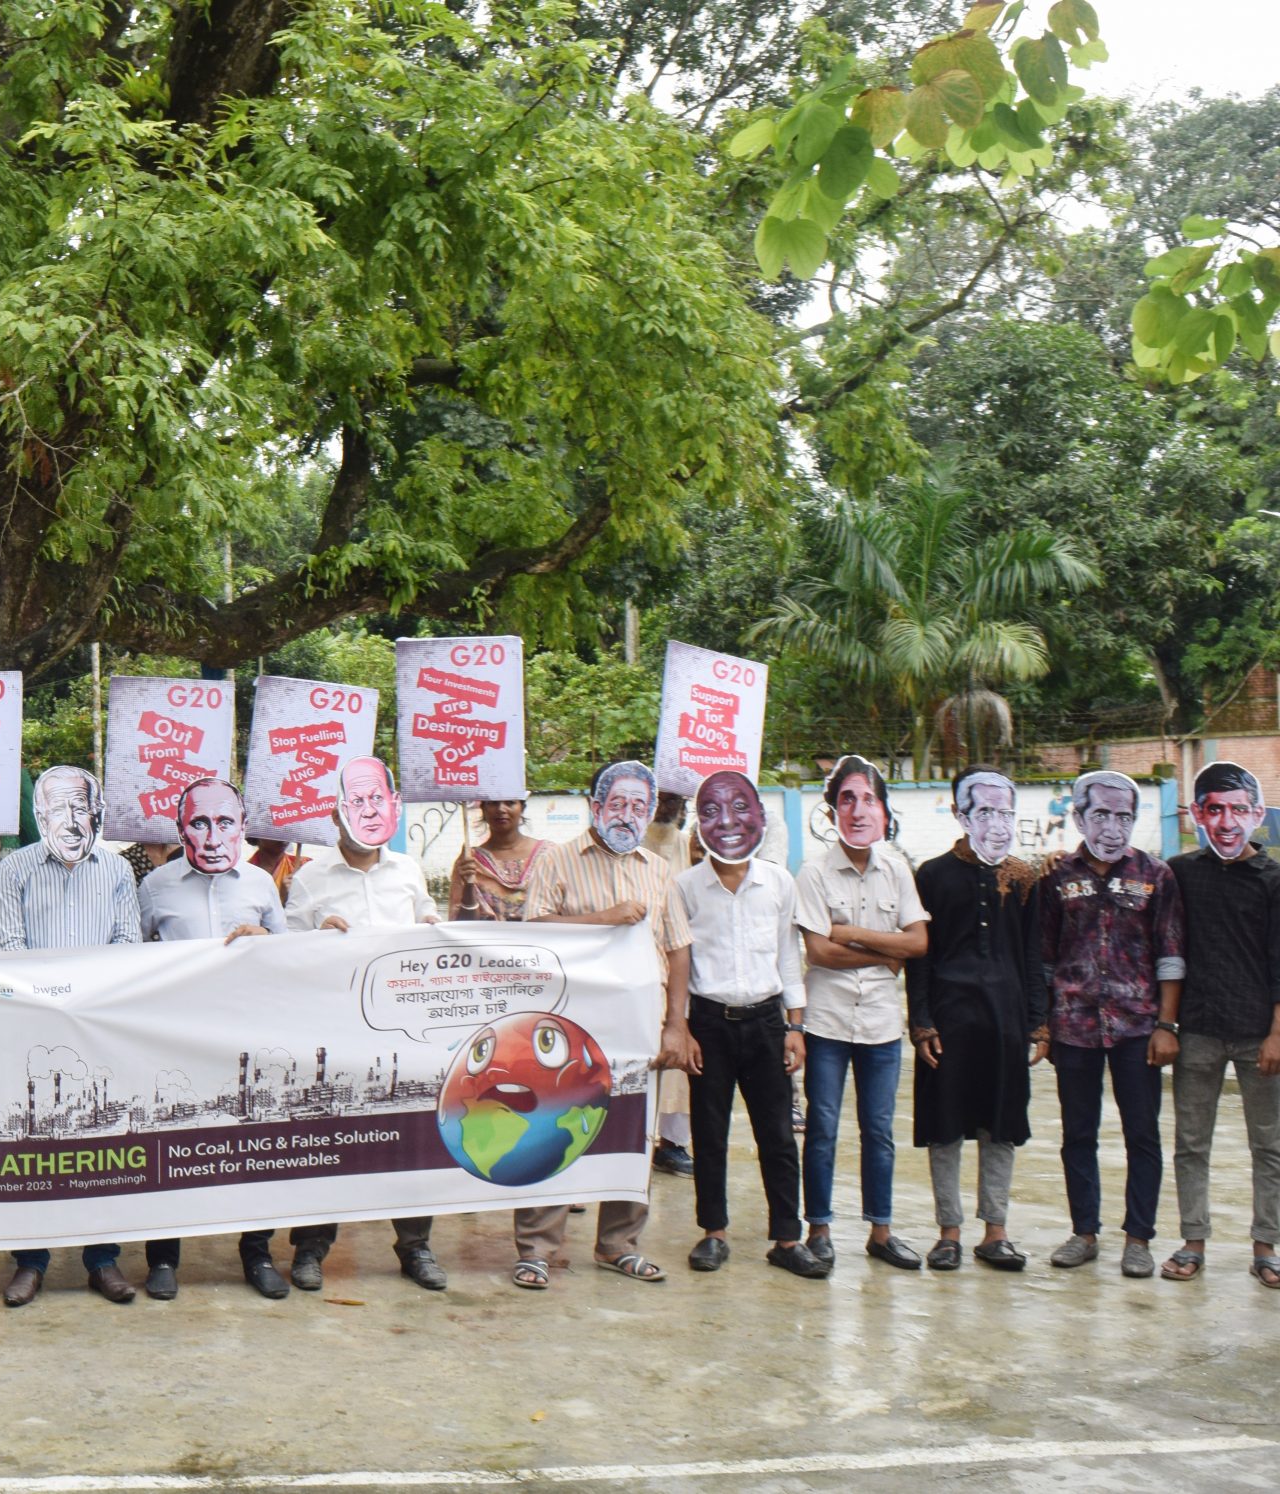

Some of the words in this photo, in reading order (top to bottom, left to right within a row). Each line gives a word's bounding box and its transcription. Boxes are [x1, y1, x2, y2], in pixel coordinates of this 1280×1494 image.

[450, 644, 505, 667] G20
[712, 660, 756, 687] G20
[423, 673, 443, 685] Your
[444, 678, 496, 698] Investments
[167, 685, 223, 709] G20
[309, 687, 363, 714] G20
[691, 687, 734, 707] Support
[442, 700, 468, 714] are
[705, 711, 725, 723] for
[154, 719, 193, 745] Out
[417, 717, 499, 741] Destroying
[688, 720, 729, 750] 100%
[272, 736, 297, 748] Stop
[299, 731, 345, 744] Fuelling
[143, 746, 179, 760] from
[301, 751, 325, 766] Coal
[443, 740, 475, 762] Our
[682, 751, 746, 767] Renewabls
[292, 767, 316, 782] LNG
[438, 768, 477, 782] Lives
[295, 787, 303, 797] &
[272, 806, 298, 820] False
[300, 799, 338, 816] Solutio
[400, 960, 429, 975] Hey
[436, 954, 472, 970] G20
[479, 954, 541, 968] Leaders!
[456, 975, 468, 984] বা
[33, 983, 72, 997] bwged
[478, 983, 545, 1000] জ্বালানিতে
[484, 999, 508, 1014] চাই
[169, 1145, 191, 1158] No
[195, 1140, 234, 1156] Coal,
[238, 1137, 272, 1153] LNG
[276, 1137, 288, 1149] &
[291, 1133, 331, 1148] False
[335, 1129, 400, 1145] Solution
[169, 1161, 216, 1178] Invest
[220, 1158, 242, 1174] for
[246, 1152, 341, 1171] Renewables
[26, 1180, 53, 1191] 2023
[69, 1173, 147, 1190] Maymenshingh
